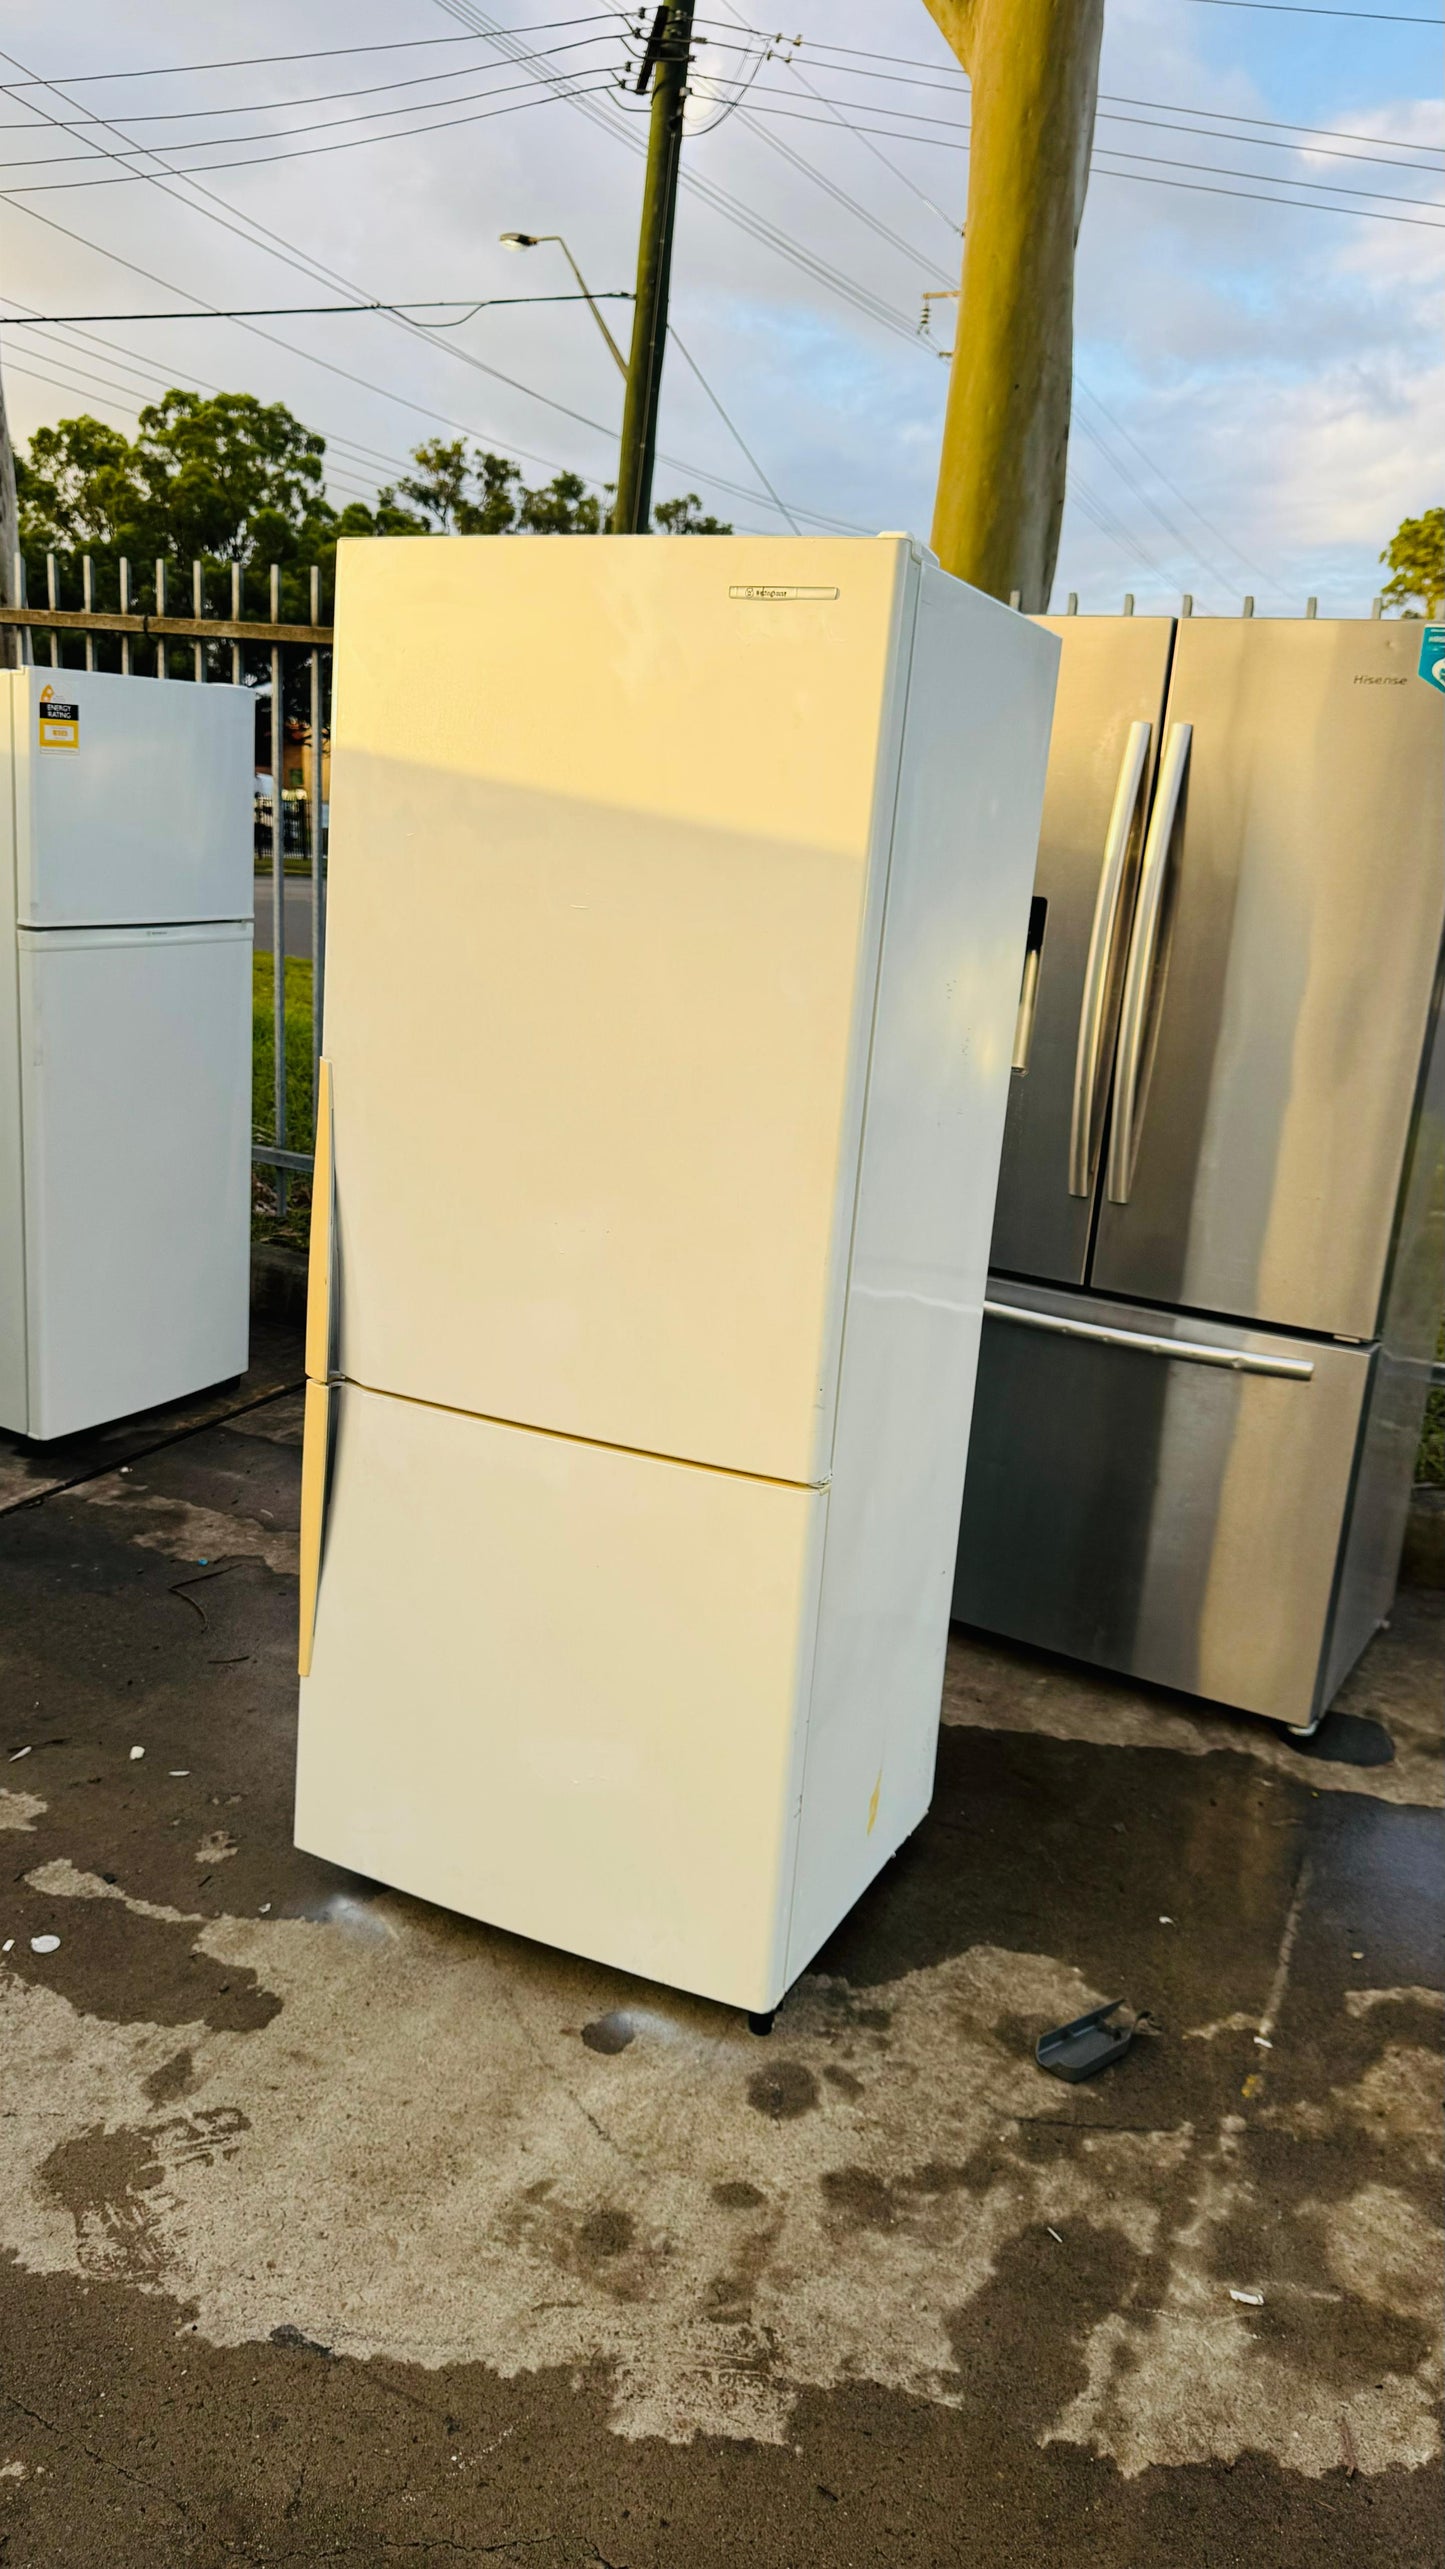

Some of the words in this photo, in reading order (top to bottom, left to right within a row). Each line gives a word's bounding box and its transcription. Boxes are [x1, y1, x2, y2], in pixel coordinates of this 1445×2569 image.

[1353, 675, 1408, 686] Hisense
[47, 704, 71, 712] ENERGY
[47, 711, 72, 719] RATING
